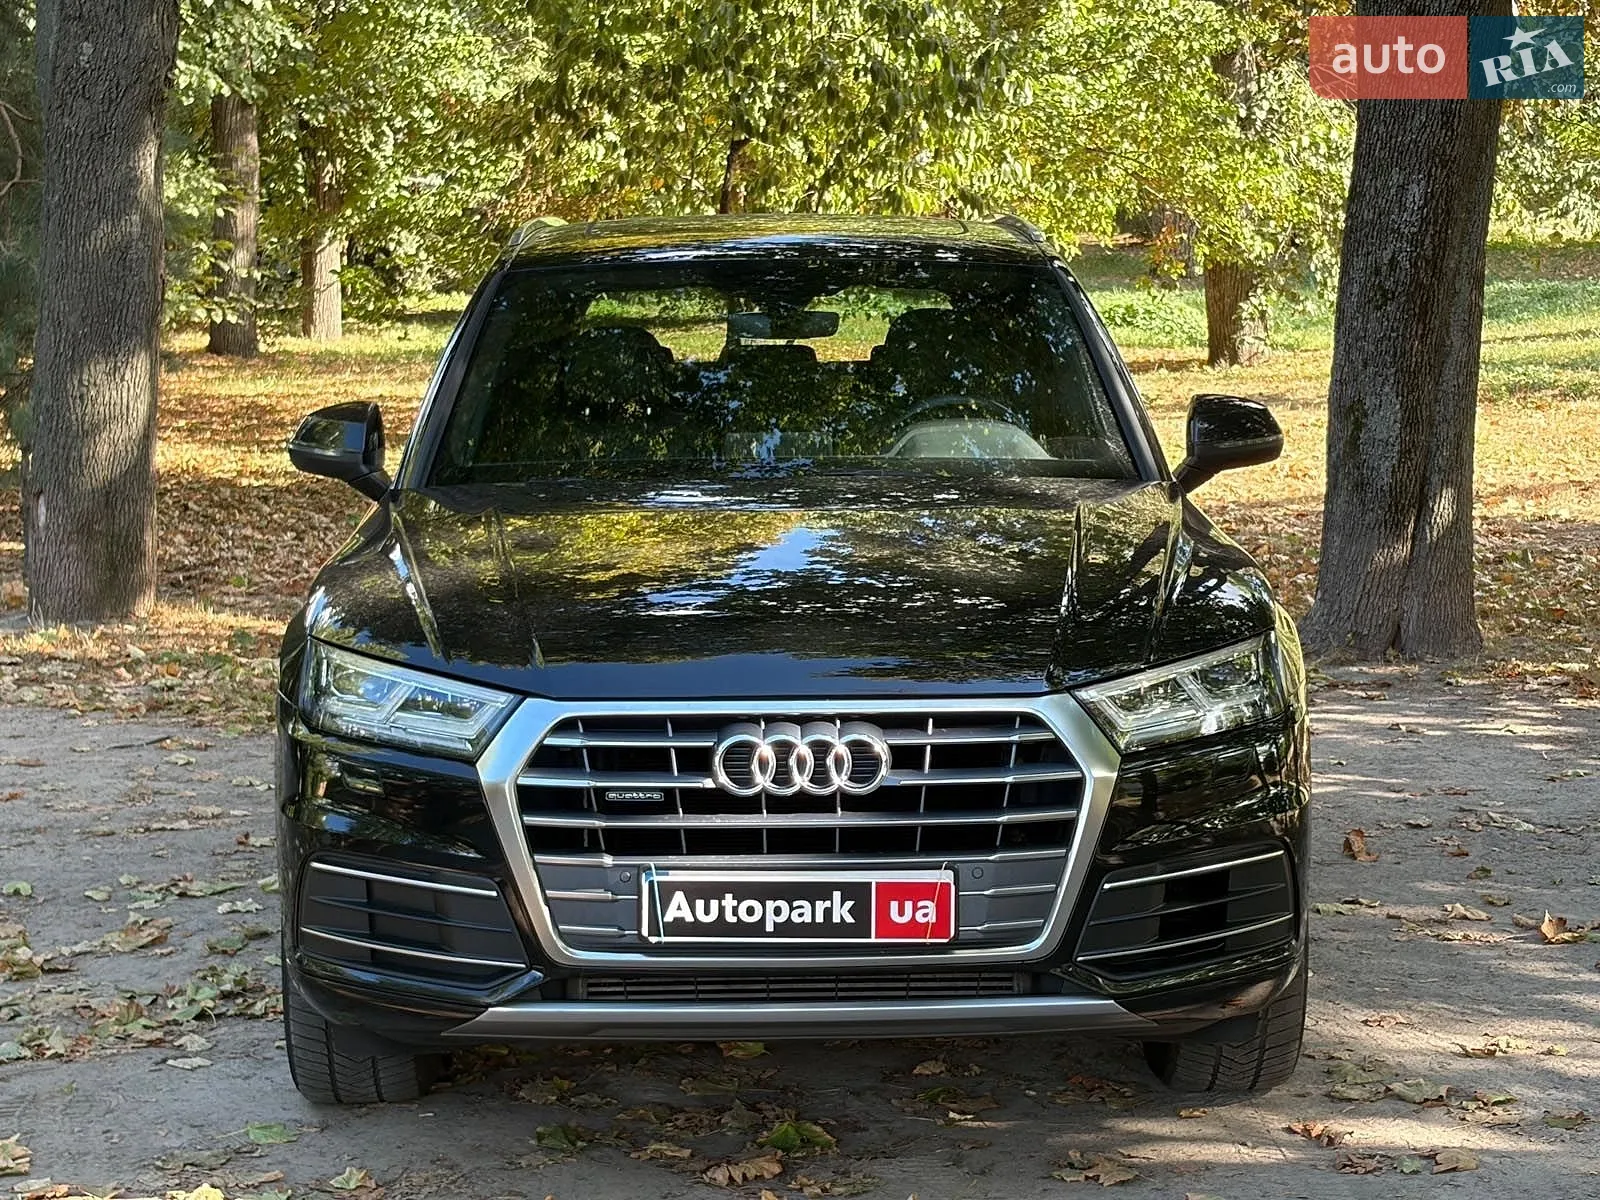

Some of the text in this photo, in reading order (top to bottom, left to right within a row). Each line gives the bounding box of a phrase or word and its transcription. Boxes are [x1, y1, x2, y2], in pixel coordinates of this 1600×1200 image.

[608, 792, 661, 800] quattro
[663, 890, 937, 932] Autopark ua
